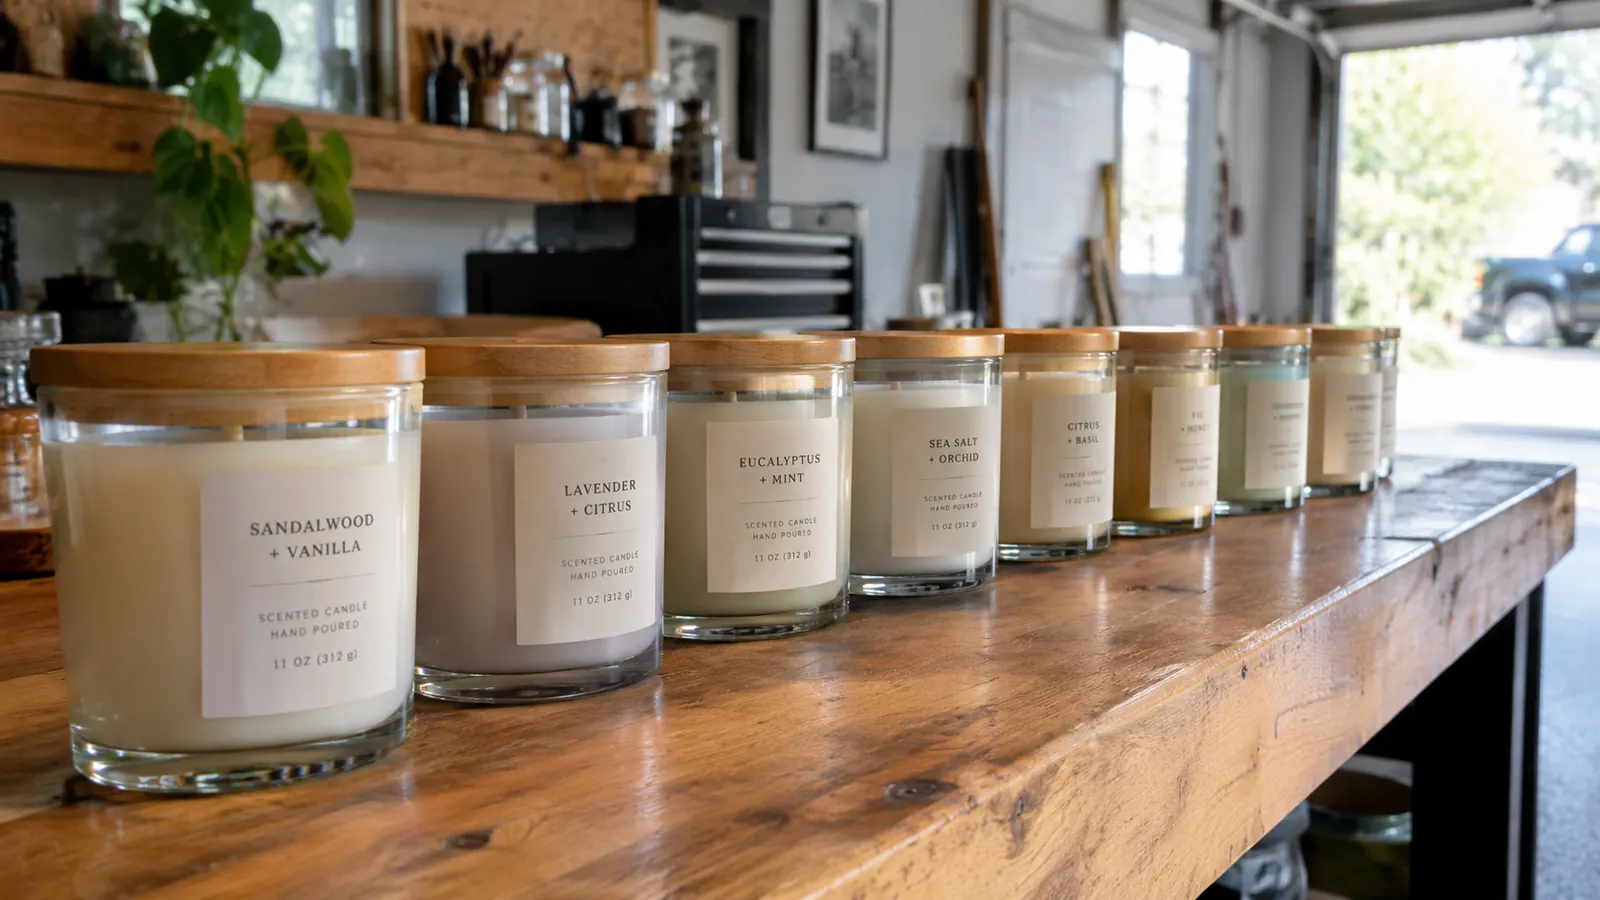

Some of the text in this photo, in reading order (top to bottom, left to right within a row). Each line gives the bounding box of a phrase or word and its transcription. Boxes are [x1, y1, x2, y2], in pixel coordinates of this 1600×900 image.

[1068, 421, 1100, 431] CITRUS
[930, 438, 978, 448] SEA SALT
[1076, 435, 1099, 444] BASIL
[740, 454, 821, 468] EUCALYPTUS
[939, 453, 979, 463] ORCHID
[772, 473, 805, 484] MINT
[565, 480, 636, 496] LAVENDER
[571, 501, 632, 516] + CITRUS
[250, 514, 374, 536] SANDALWOOD
[745, 517, 817, 529] SCENTED CANDLE
[753, 530, 812, 540] HAND POURED
[270, 540, 362, 559] + VANILLA
[783, 552, 800, 561] (312
[804, 550, 811, 560] g)
[562, 551, 639, 568] SCENTED CANDLE
[571, 566, 634, 581] HAND POURED
[573, 590, 633, 606] 11 OZ (312 g)
[259, 601, 368, 623] SCENTED CANDLE
[271, 621, 359, 640] HAND POURED
[274, 649, 357, 670] 11 OZ (312 g)
